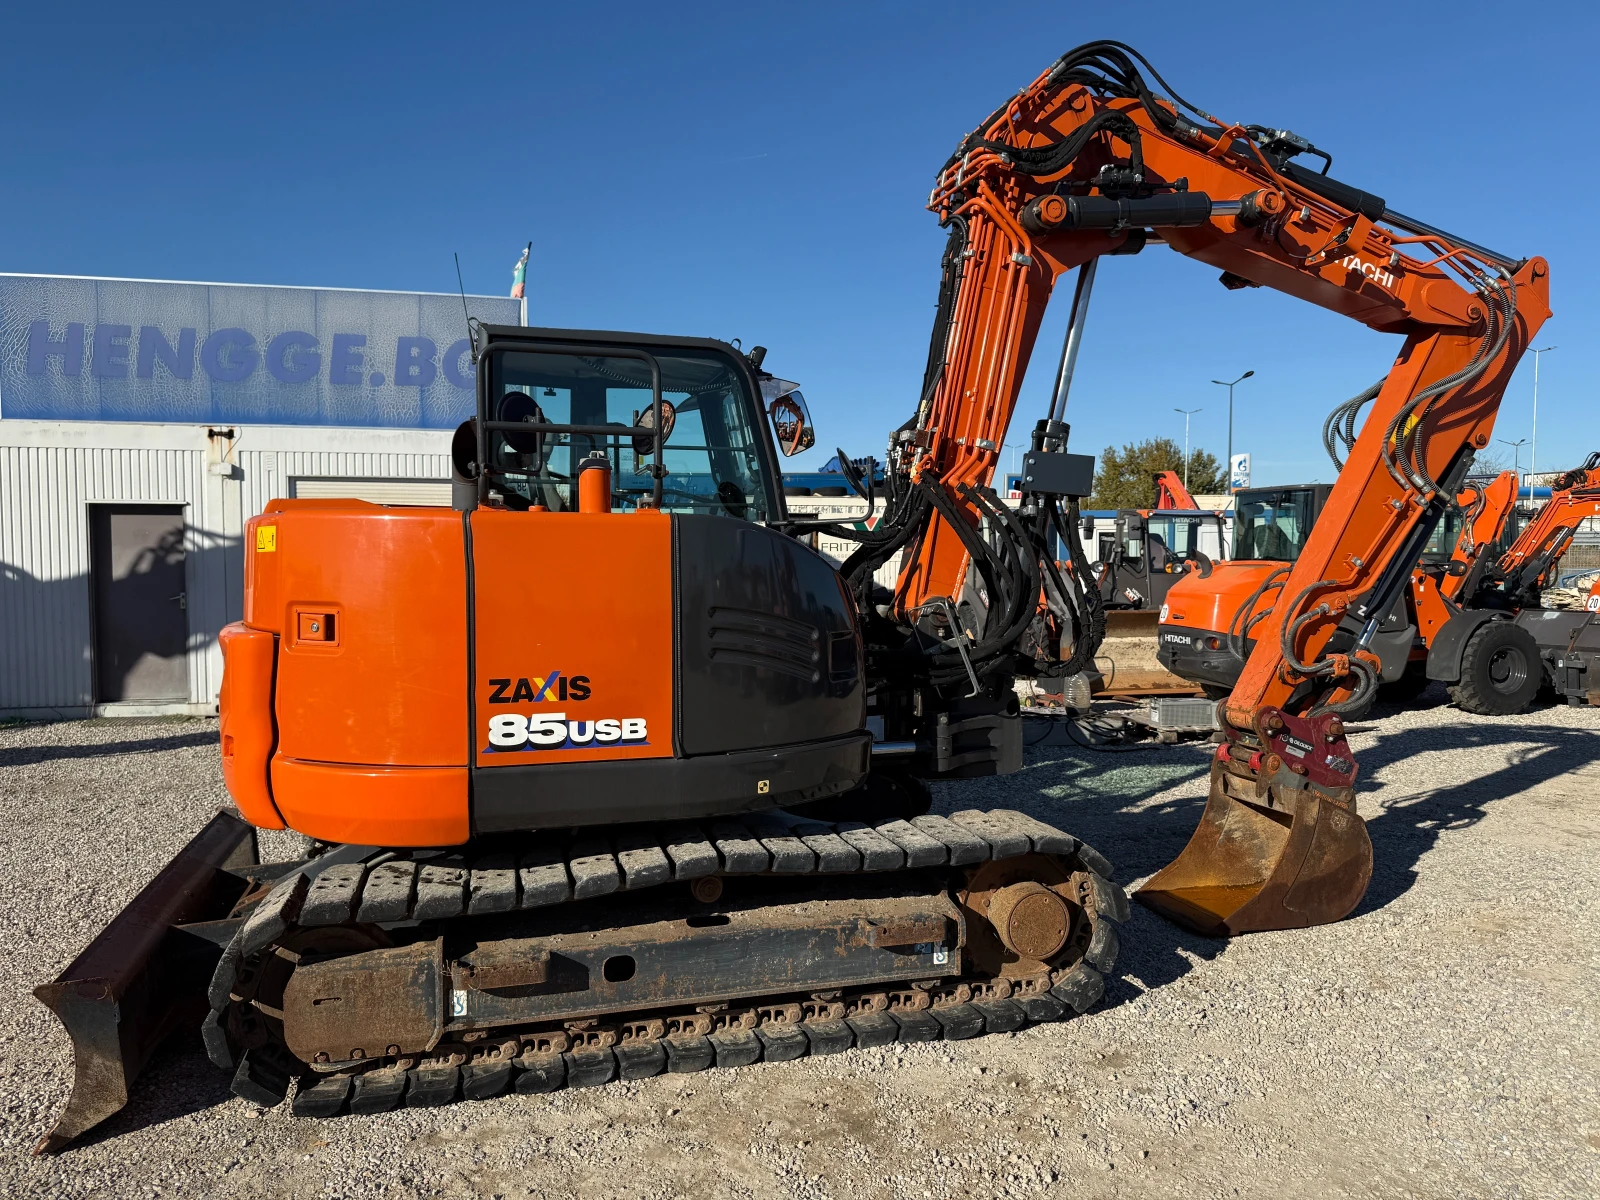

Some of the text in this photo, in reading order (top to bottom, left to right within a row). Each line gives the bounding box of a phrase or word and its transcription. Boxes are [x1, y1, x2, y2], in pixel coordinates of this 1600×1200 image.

[1321, 250, 1395, 288] TACHI
[27, 320, 476, 390] HENGGE.BG
[1164, 634, 1191, 645] HITACHI
[488, 670, 592, 704] ZAXIS
